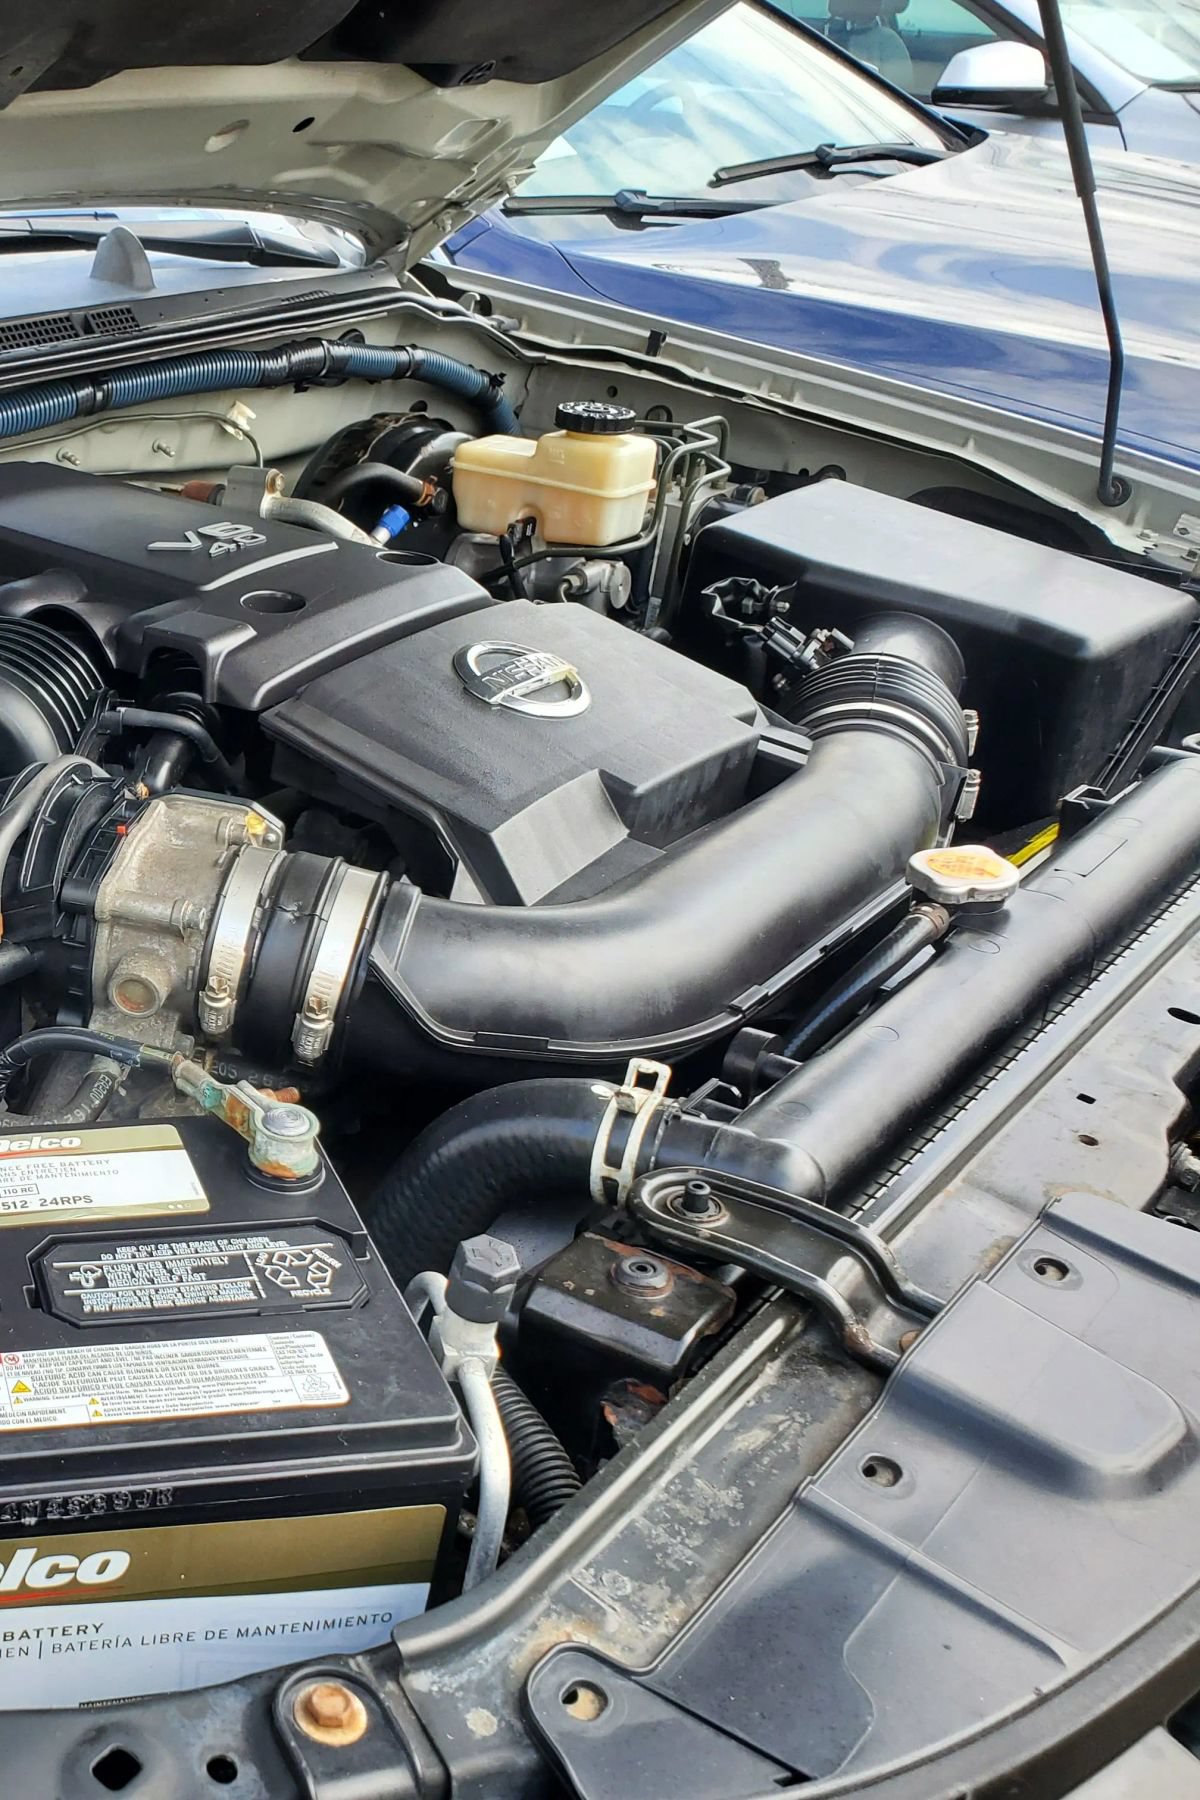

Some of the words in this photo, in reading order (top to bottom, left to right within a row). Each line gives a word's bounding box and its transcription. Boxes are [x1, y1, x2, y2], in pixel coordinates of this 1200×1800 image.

[147, 521, 253, 551] V6
[209, 532, 267, 557] 4.0
[21, 1167, 76, 1176] ENTRETIEN
[26, 1161, 54, 1170] FREE
[59, 1159, 111, 1168] BATTERY
[36, 1169, 120, 1181] MANTENIMIENTO
[3, 1188, 18, 1196] 110
[39, 1195, 94, 1207] 24RPS
[103, 1263, 135, 1273] FLUSH
[137, 1261, 162, 1271] EYES
[164, 1256, 228, 1269] IMMEDIATELY
[106, 1271, 132, 1280] WITH
[172, 1267, 192, 1276] GET
[108, 1277, 151, 1288] MEDICAL
[153, 1275, 178, 1285] HELP
[182, 1273, 206, 1283] FAST
[3, 1622, 106, 1641] BATTERY
[51, 1633, 135, 1655] BATERÍA
[140, 1630, 198, 1645] LIBRE
[205, 1626, 229, 1641] DE
[236, 1612, 394, 1638] MANTENIMIENTO
